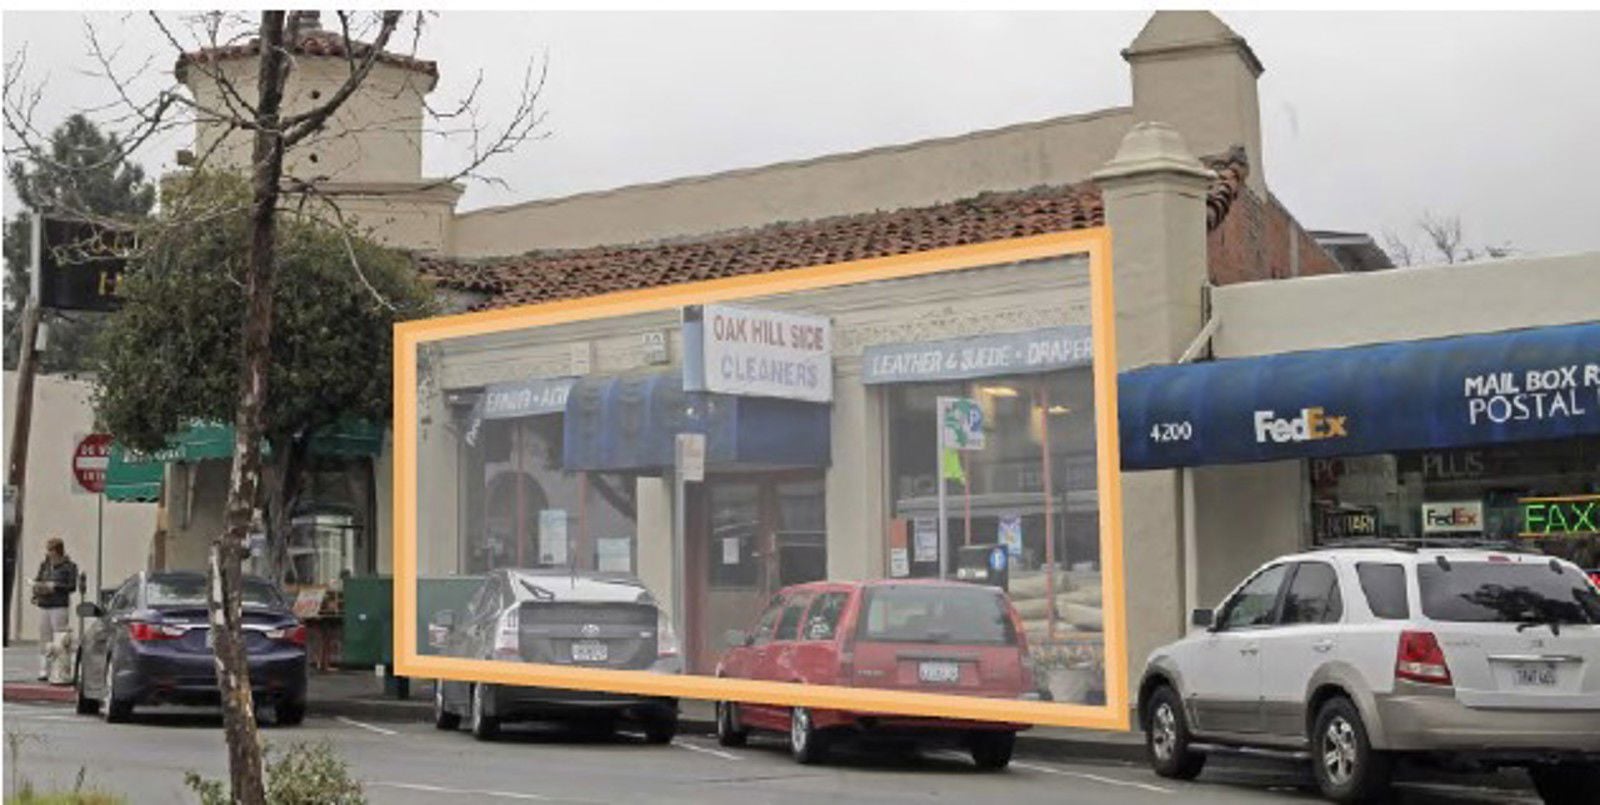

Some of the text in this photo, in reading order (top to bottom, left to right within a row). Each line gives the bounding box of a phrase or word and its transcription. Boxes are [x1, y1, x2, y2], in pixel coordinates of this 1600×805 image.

[713, 315, 748, 343] OAK
[750, 318, 786, 346] HILL
[721, 355, 819, 389] CLEANERS
[873, 351, 942, 376] LEATHER
[961, 346, 1012, 371] SUEDE
[1464, 372, 1520, 397] MAIL
[1526, 365, 1579, 392] BOX
[1469, 388, 1587, 425] POSTAL
[1150, 421, 1192, 442] 4200
[1254, 406, 1348, 443] FedEx
[1427, 507, 1478, 526] FedEx
[1525, 502, 1599, 535] FAX
